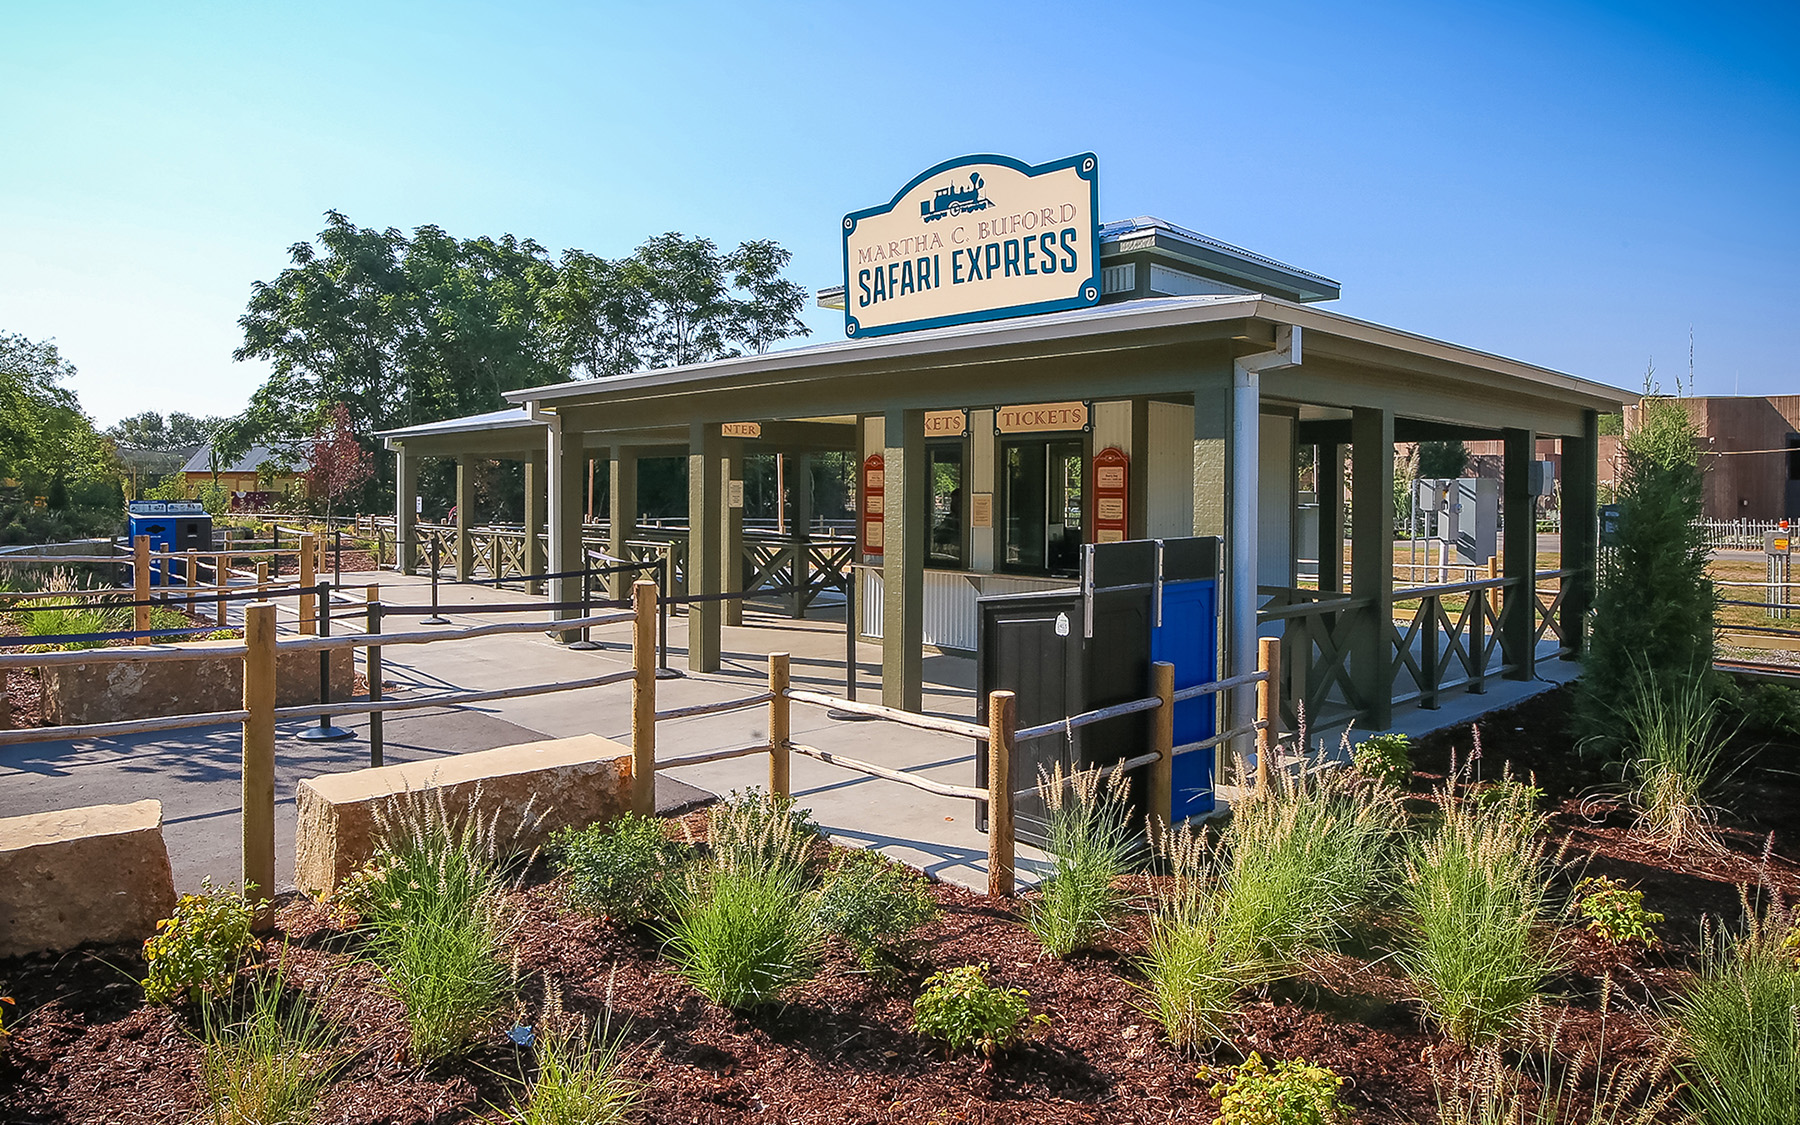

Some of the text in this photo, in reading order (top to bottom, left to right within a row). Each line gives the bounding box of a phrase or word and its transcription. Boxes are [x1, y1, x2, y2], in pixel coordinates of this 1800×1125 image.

[858, 203, 1077, 265] MARTHA C. BUFORD
[859, 228, 1077, 308] SAFARI EXPRESS
[924, 415, 961, 431] KETS
[1002, 409, 1082, 427] TICKETS
[723, 424, 756, 435] NTER
